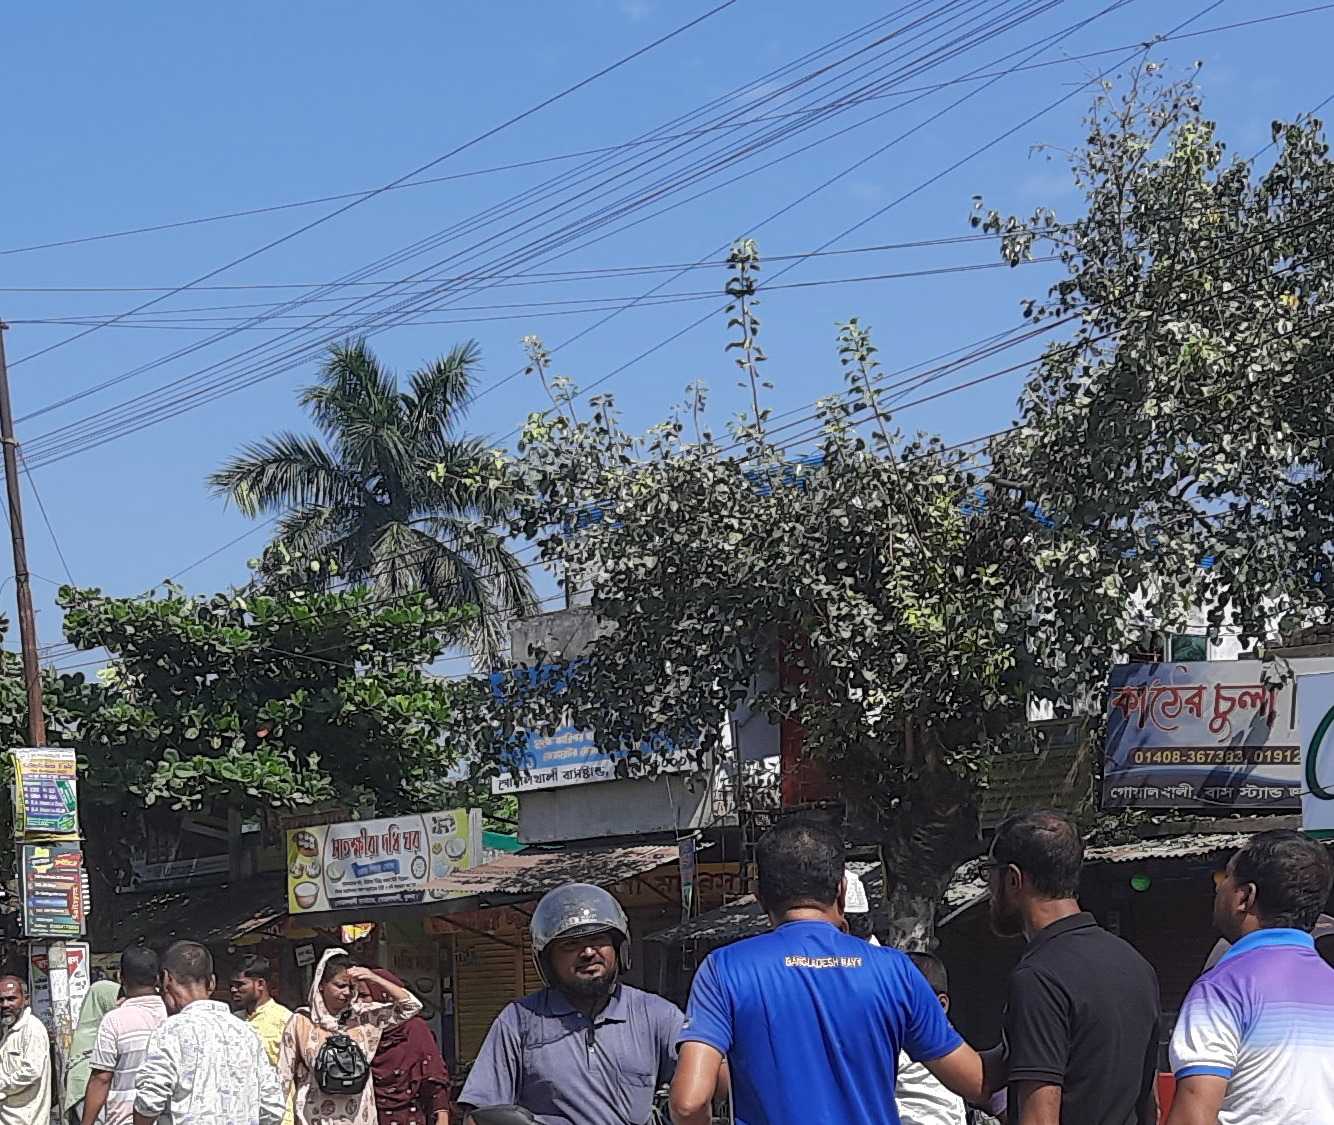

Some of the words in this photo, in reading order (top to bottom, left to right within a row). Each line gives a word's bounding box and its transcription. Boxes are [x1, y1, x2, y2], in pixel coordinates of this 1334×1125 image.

[1111, 665, 1206, 731] কাঠের
[1208, 682, 1275, 743] চুলা
[1134, 749, 1248, 765] 01408-367383,
[1205, 785, 1234, 799] বাস
[785, 956, 839, 968] BANGLADESH
